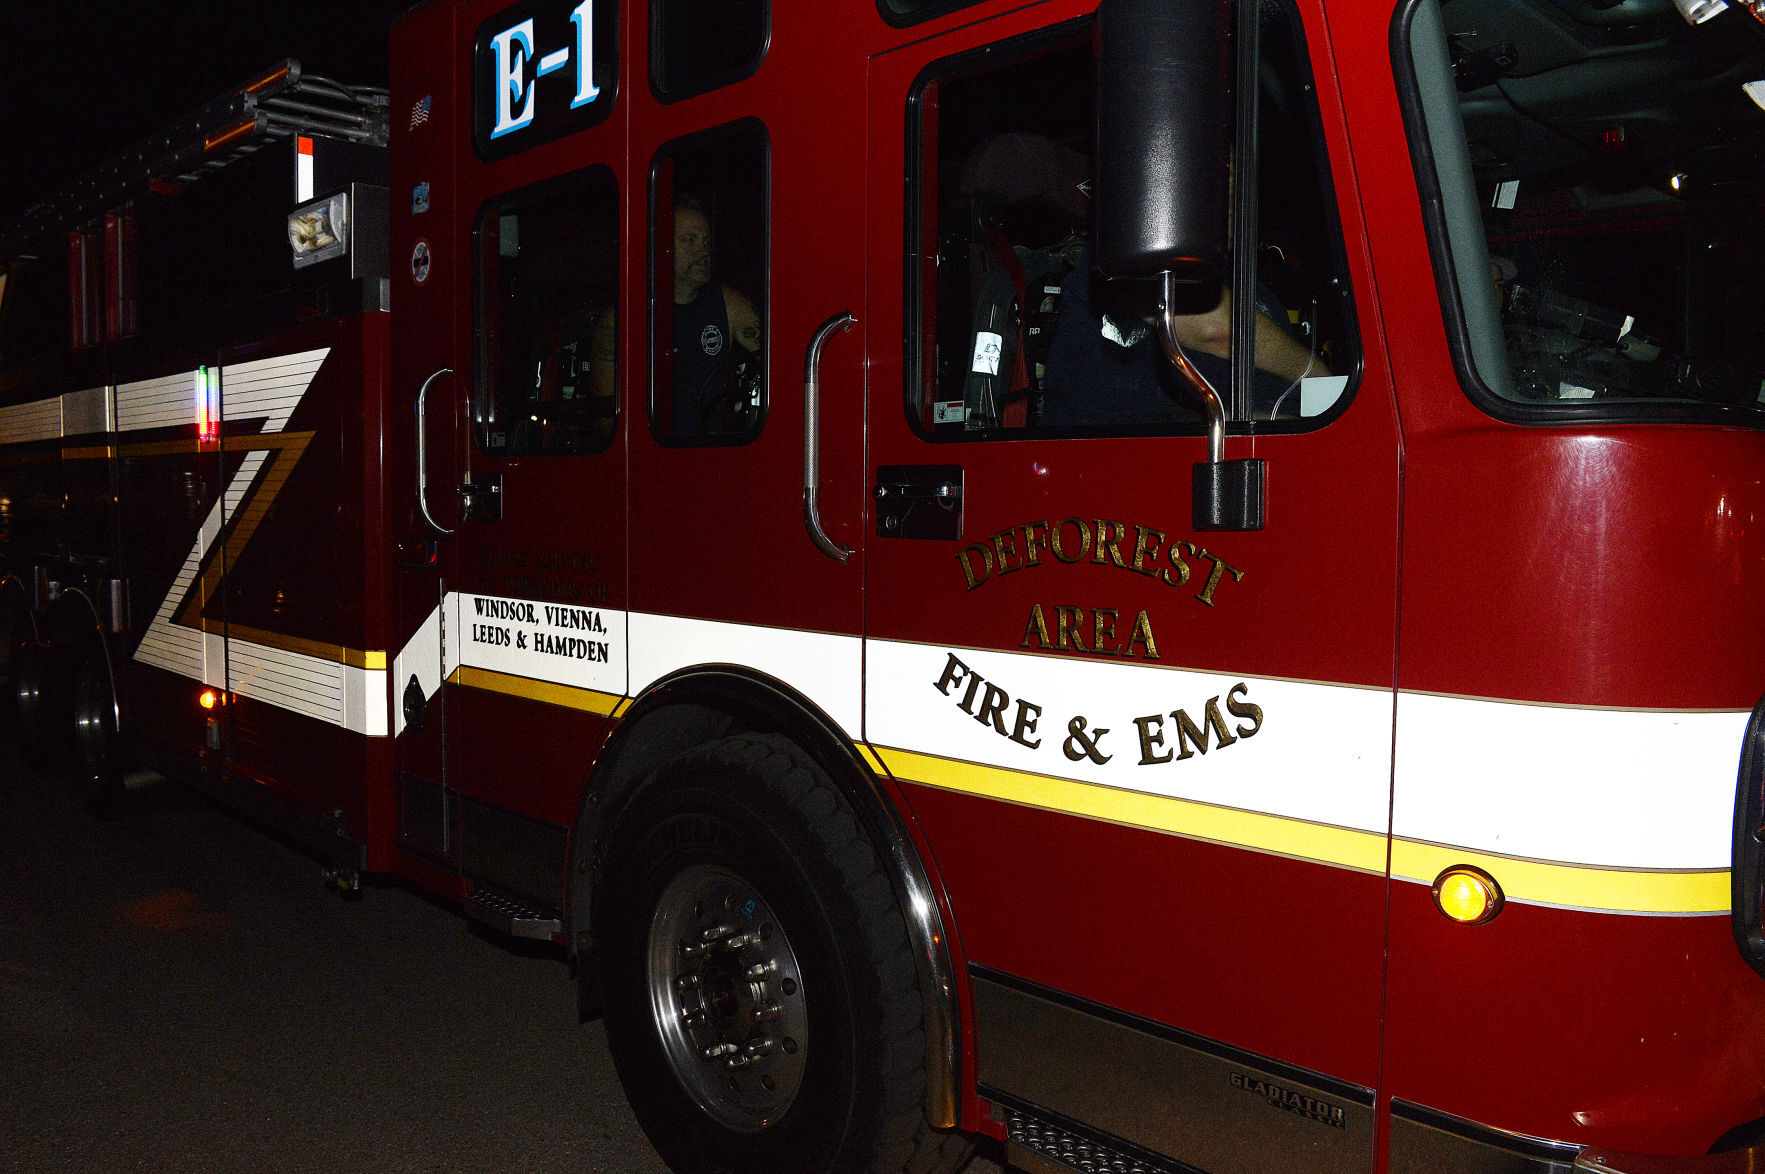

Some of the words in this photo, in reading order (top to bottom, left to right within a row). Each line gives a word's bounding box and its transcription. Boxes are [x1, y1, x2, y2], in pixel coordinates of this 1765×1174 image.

[490, 0, 600, 140] E-1
[954, 518, 1245, 607] DEFOREST
[473, 624, 511, 647] LEEDS
[516, 630, 527, 650] &
[534, 632, 609, 663] HAMPDEN
[474, 598, 540, 625] WINDSOR,
[545, 605, 608, 636] VIENNA,
[1020, 603, 1160, 660] AREA
[933, 652, 1043, 750] FIRE
[1063, 715, 1113, 765] &
[1132, 682, 1264, 766] EMS
[1229, 1071, 1346, 1121] GLADIATOR
